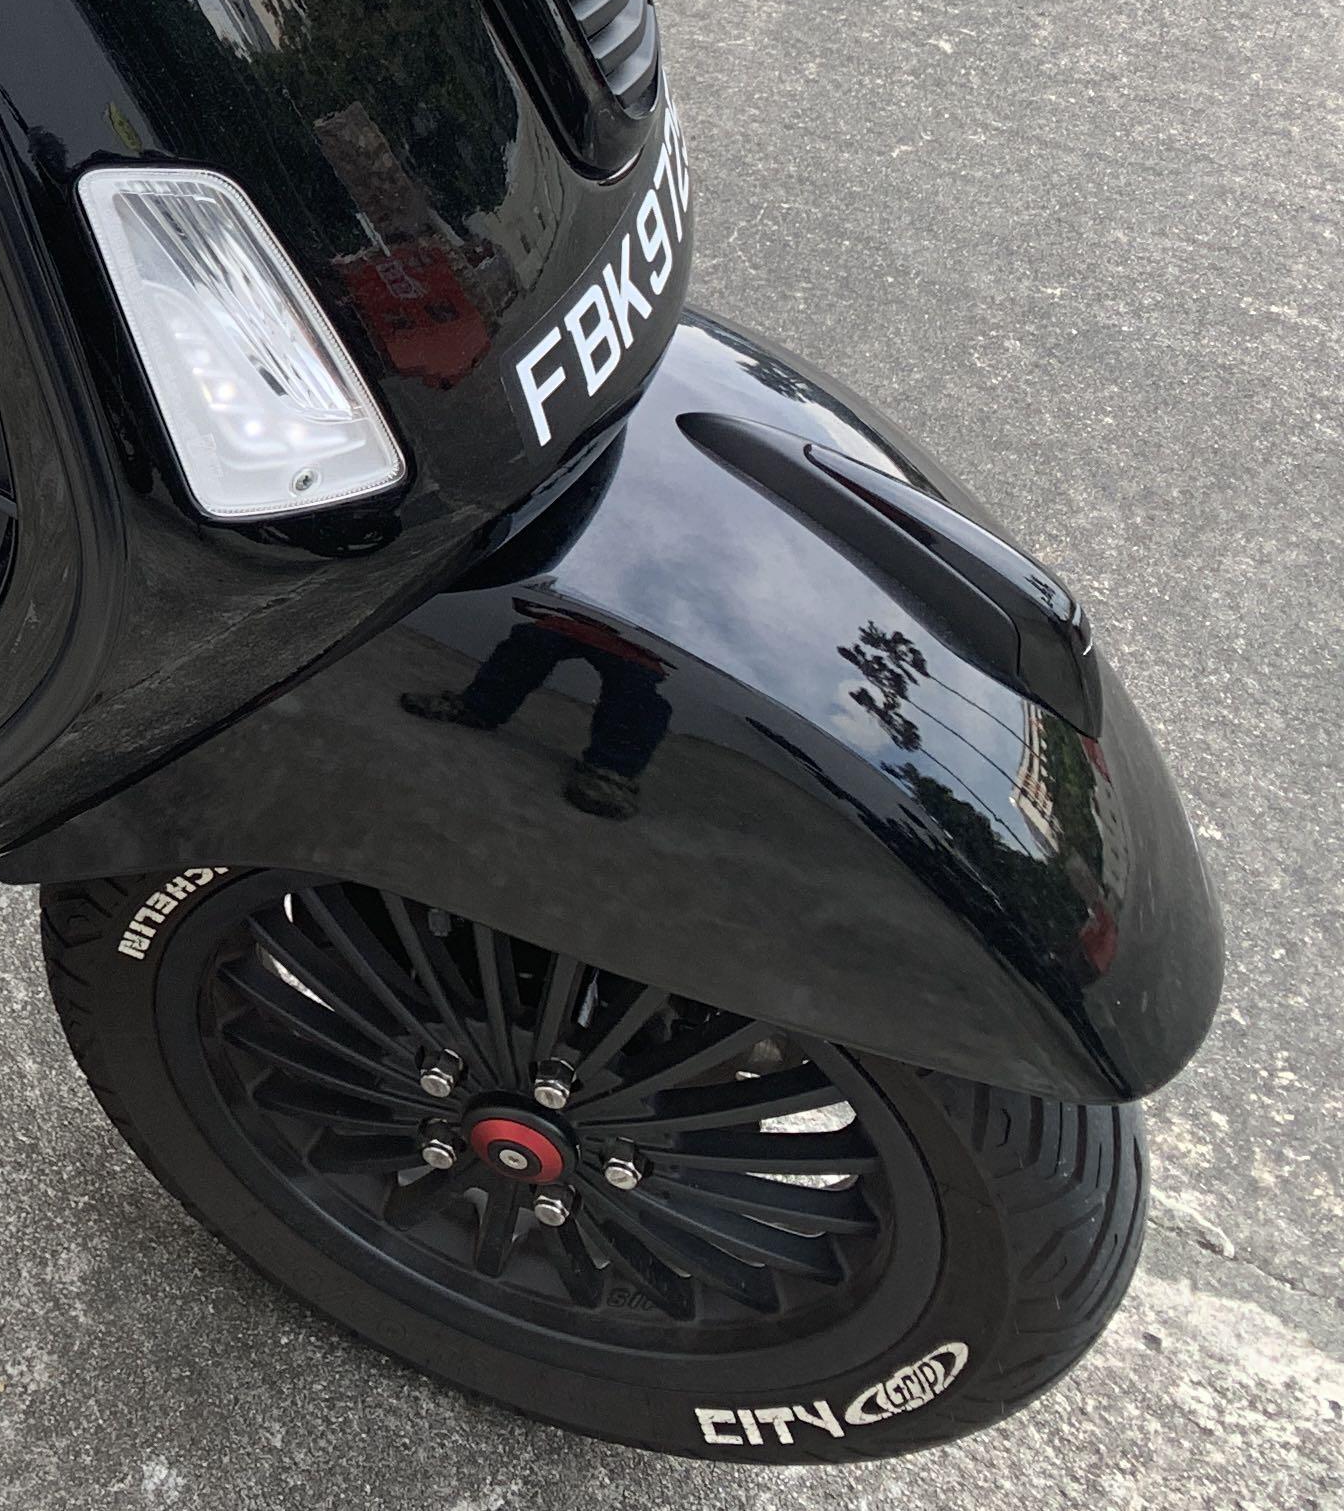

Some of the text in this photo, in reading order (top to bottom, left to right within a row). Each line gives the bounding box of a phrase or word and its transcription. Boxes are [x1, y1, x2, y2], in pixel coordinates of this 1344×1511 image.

[516, 66, 690, 447] FBK972
[118, 866, 230, 960] CHELIN
[694, 1400, 846, 1446] CITY
